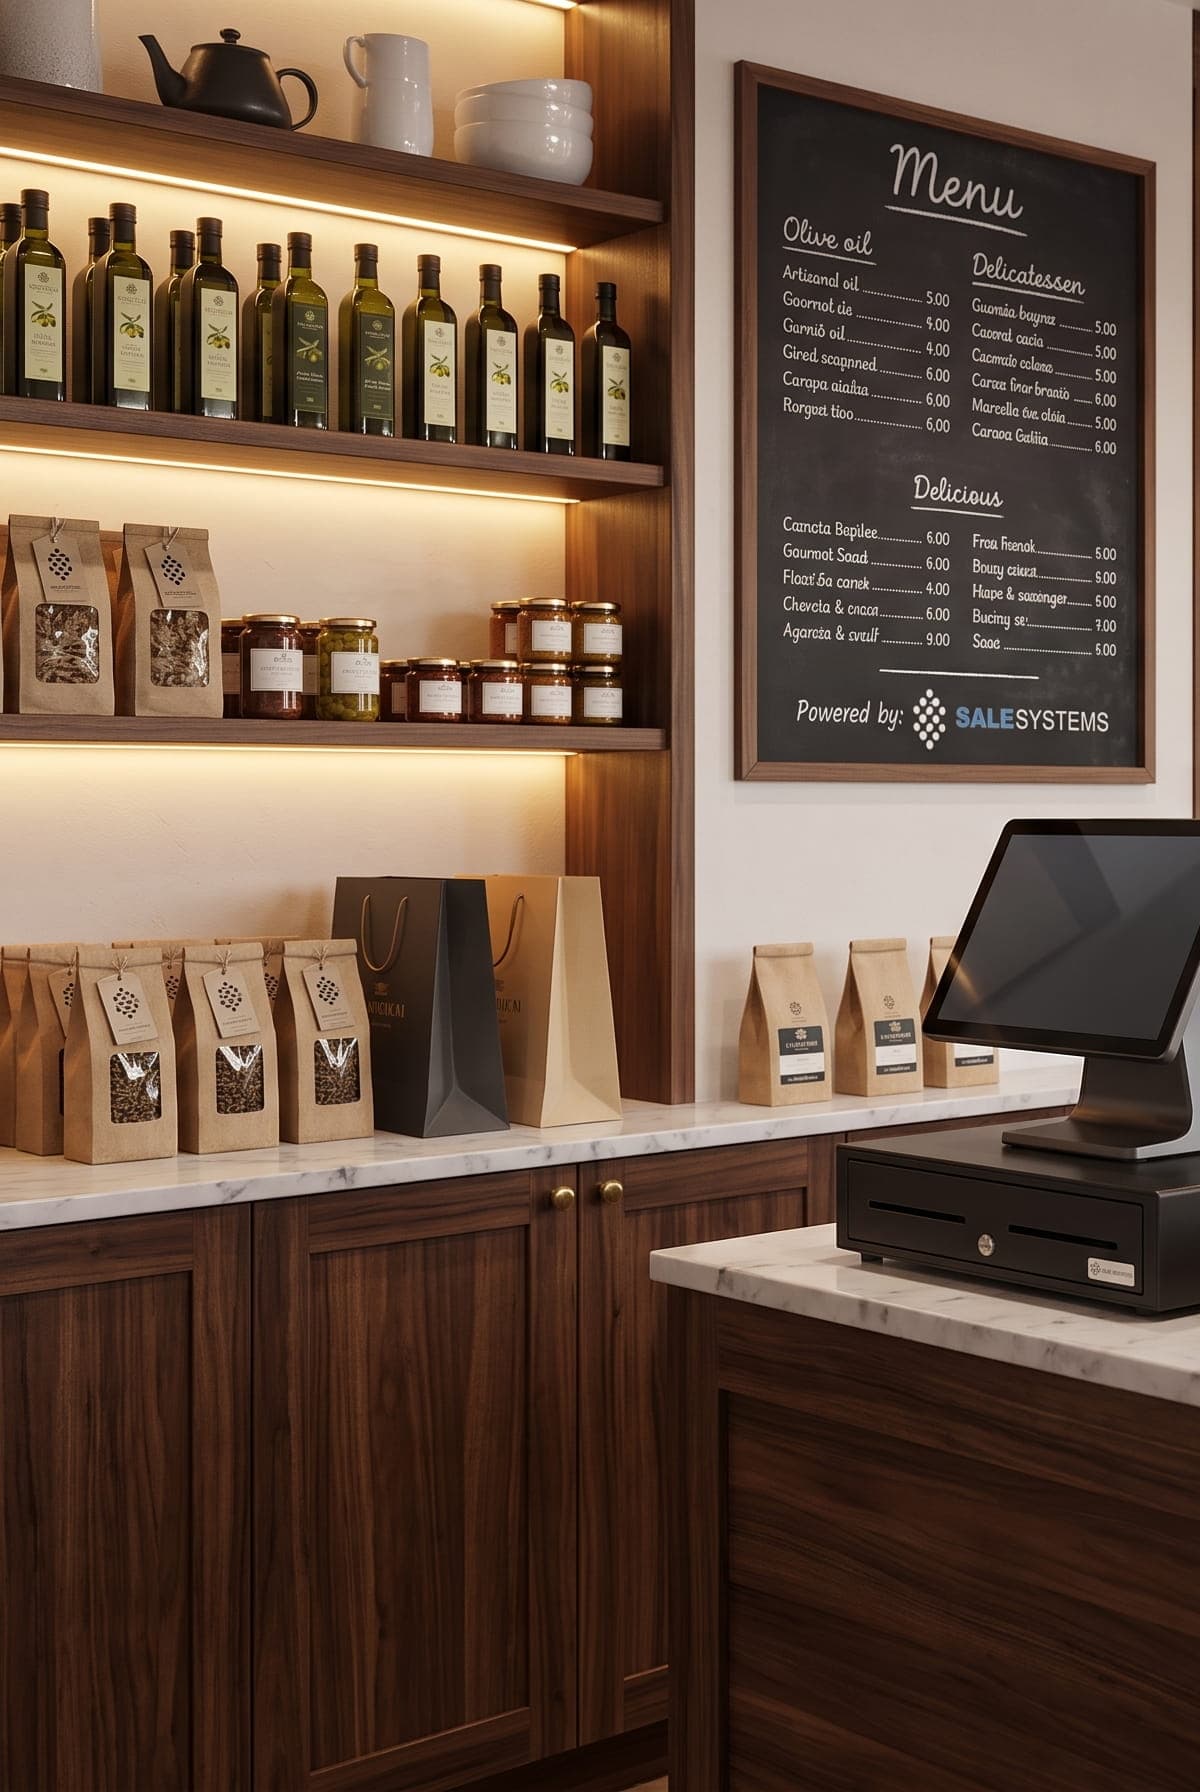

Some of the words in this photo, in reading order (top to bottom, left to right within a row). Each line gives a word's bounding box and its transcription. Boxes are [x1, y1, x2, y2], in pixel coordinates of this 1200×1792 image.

[889, 143, 1023, 219] Menu
[783, 216, 839, 249] Olive
[843, 231, 873, 255] oil
[972, 252, 1086, 296] Delicatessen
[843, 275, 860, 291] oil
[926, 291, 950, 307] 5.00
[1095, 320, 1117, 336] 5.00
[829, 325, 846, 341] oil
[926, 342, 950, 358] 4.00
[1095, 345, 1117, 361] 5.00
[926, 367, 950, 383] 6.00
[1095, 368, 1117, 384] 5.00
[1095, 393, 1117, 408] 6.00
[1095, 416, 1117, 431] 5.00
[1095, 440, 1117, 455] 6.00
[914, 474, 1004, 508] Delicious
[926, 531, 950, 546] 6.00
[926, 556, 950, 572] 6.00
[926, 581, 950, 596] 4.00
[1006, 586, 1015, 601] &
[834, 599, 845, 615] &
[926, 607, 950, 622] 6.00
[835, 625, 845, 641] &
[926, 632, 950, 647] 9.00
[797, 699, 871, 725] Powered
[877, 700, 904, 732] by:
[955, 706, 1109, 733] SALESYSTEMS
